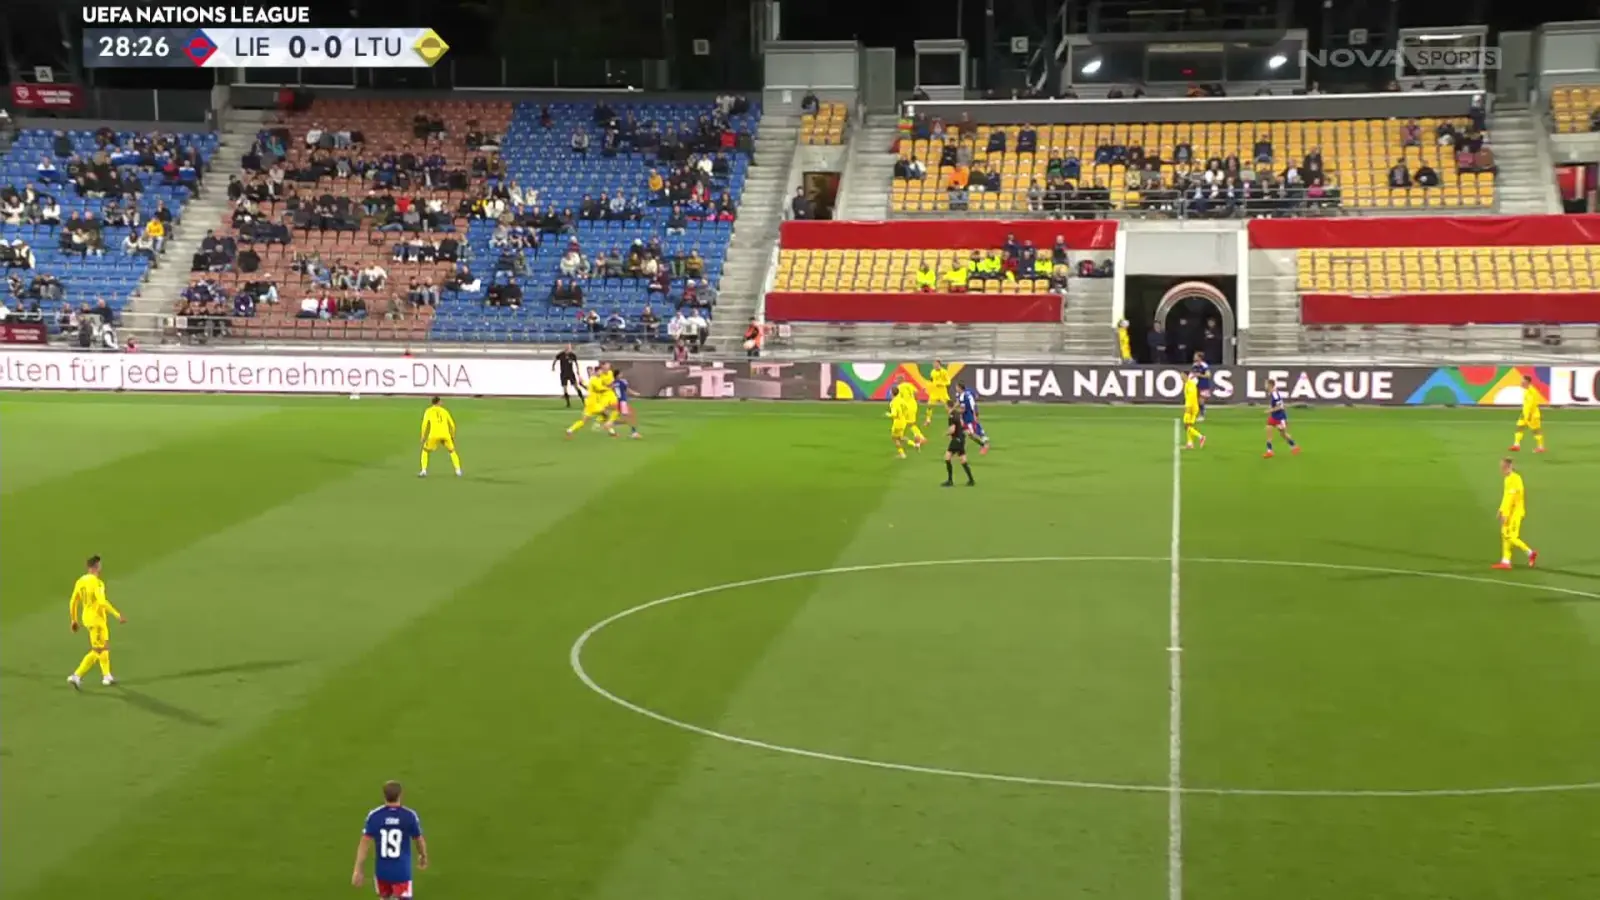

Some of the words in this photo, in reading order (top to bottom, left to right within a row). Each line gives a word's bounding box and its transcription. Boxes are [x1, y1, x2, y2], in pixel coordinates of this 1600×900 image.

[0, 356, 60, 382] lten
[69, 357, 110, 382] für
[119, 359, 179, 387] jede
[187, 359, 472, 388] Unternehmens-DNA
[975, 368, 1055, 397] UEFA
[1073, 369, 1233, 398] NATIOS
[1246, 370, 1394, 400] LEAGUE
[379, 828, 403, 858] 19
